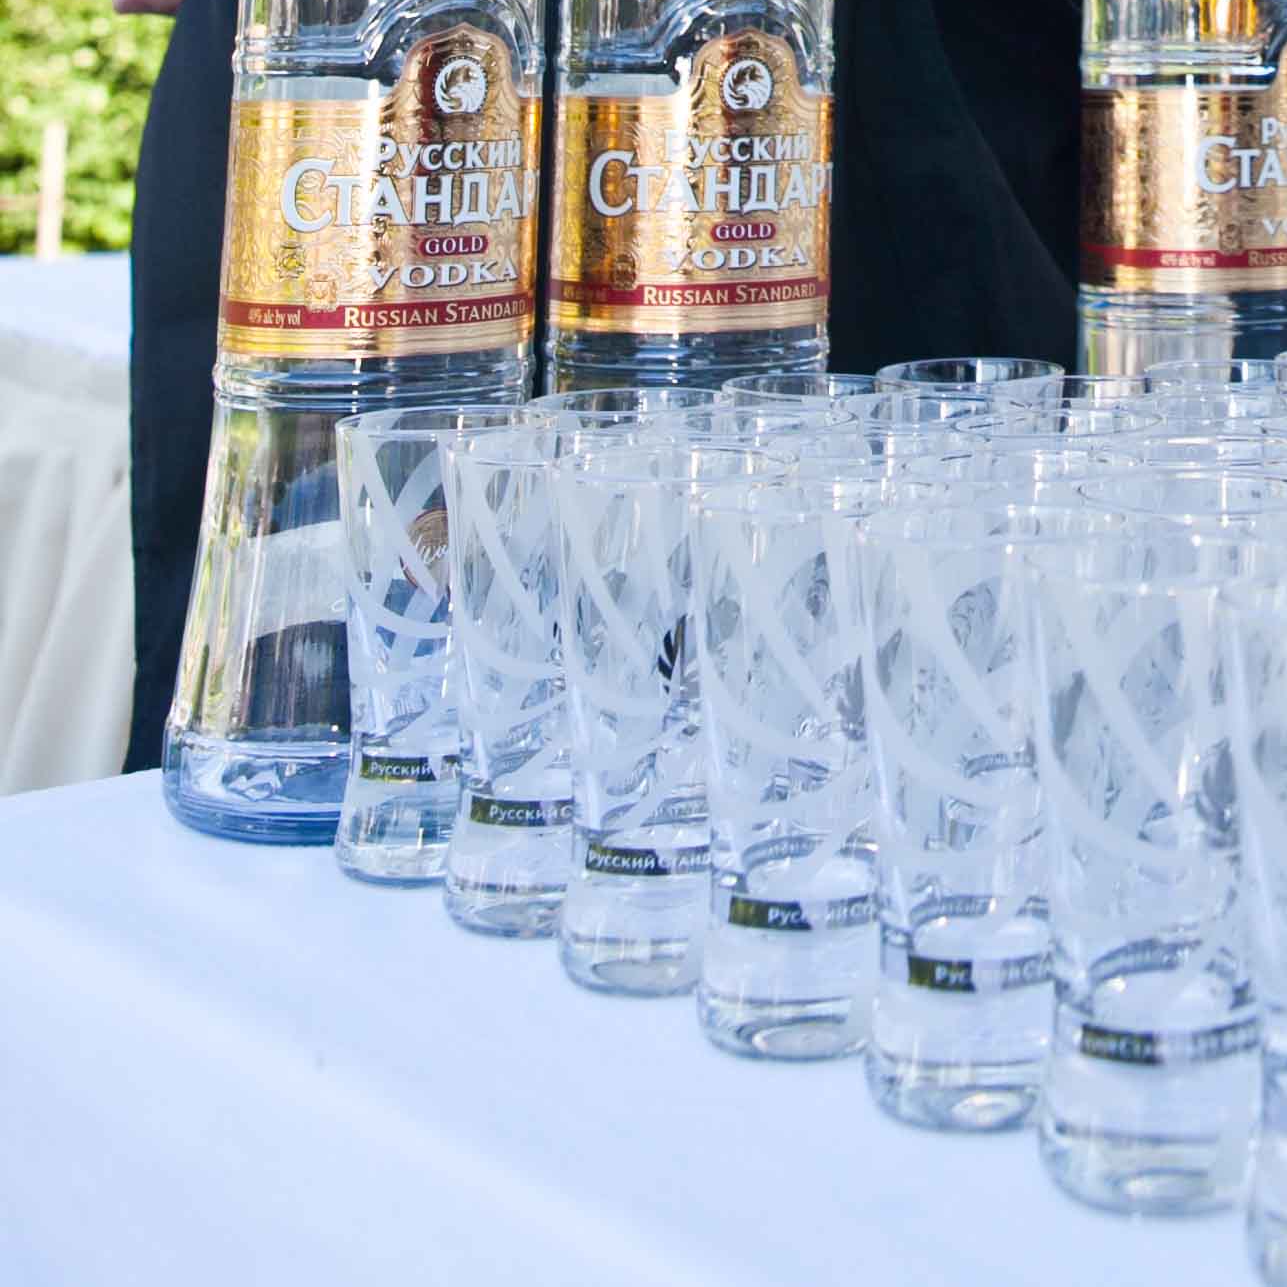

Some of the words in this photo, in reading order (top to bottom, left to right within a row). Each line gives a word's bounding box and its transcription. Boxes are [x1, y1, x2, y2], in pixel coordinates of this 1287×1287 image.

[278, 155, 540, 234] СТАНДАР
[715, 223, 772, 240] GOLD
[424, 235, 485, 256] GOLD
[664, 245, 808, 271] VODKA
[367, 256, 518, 291] VODKA
[643, 286, 729, 306] RUSSIAN
[735, 281, 817, 303] STANDARD
[343, 304, 438, 328] RUSSIAN
[445, 299, 527, 324] STANDARD
